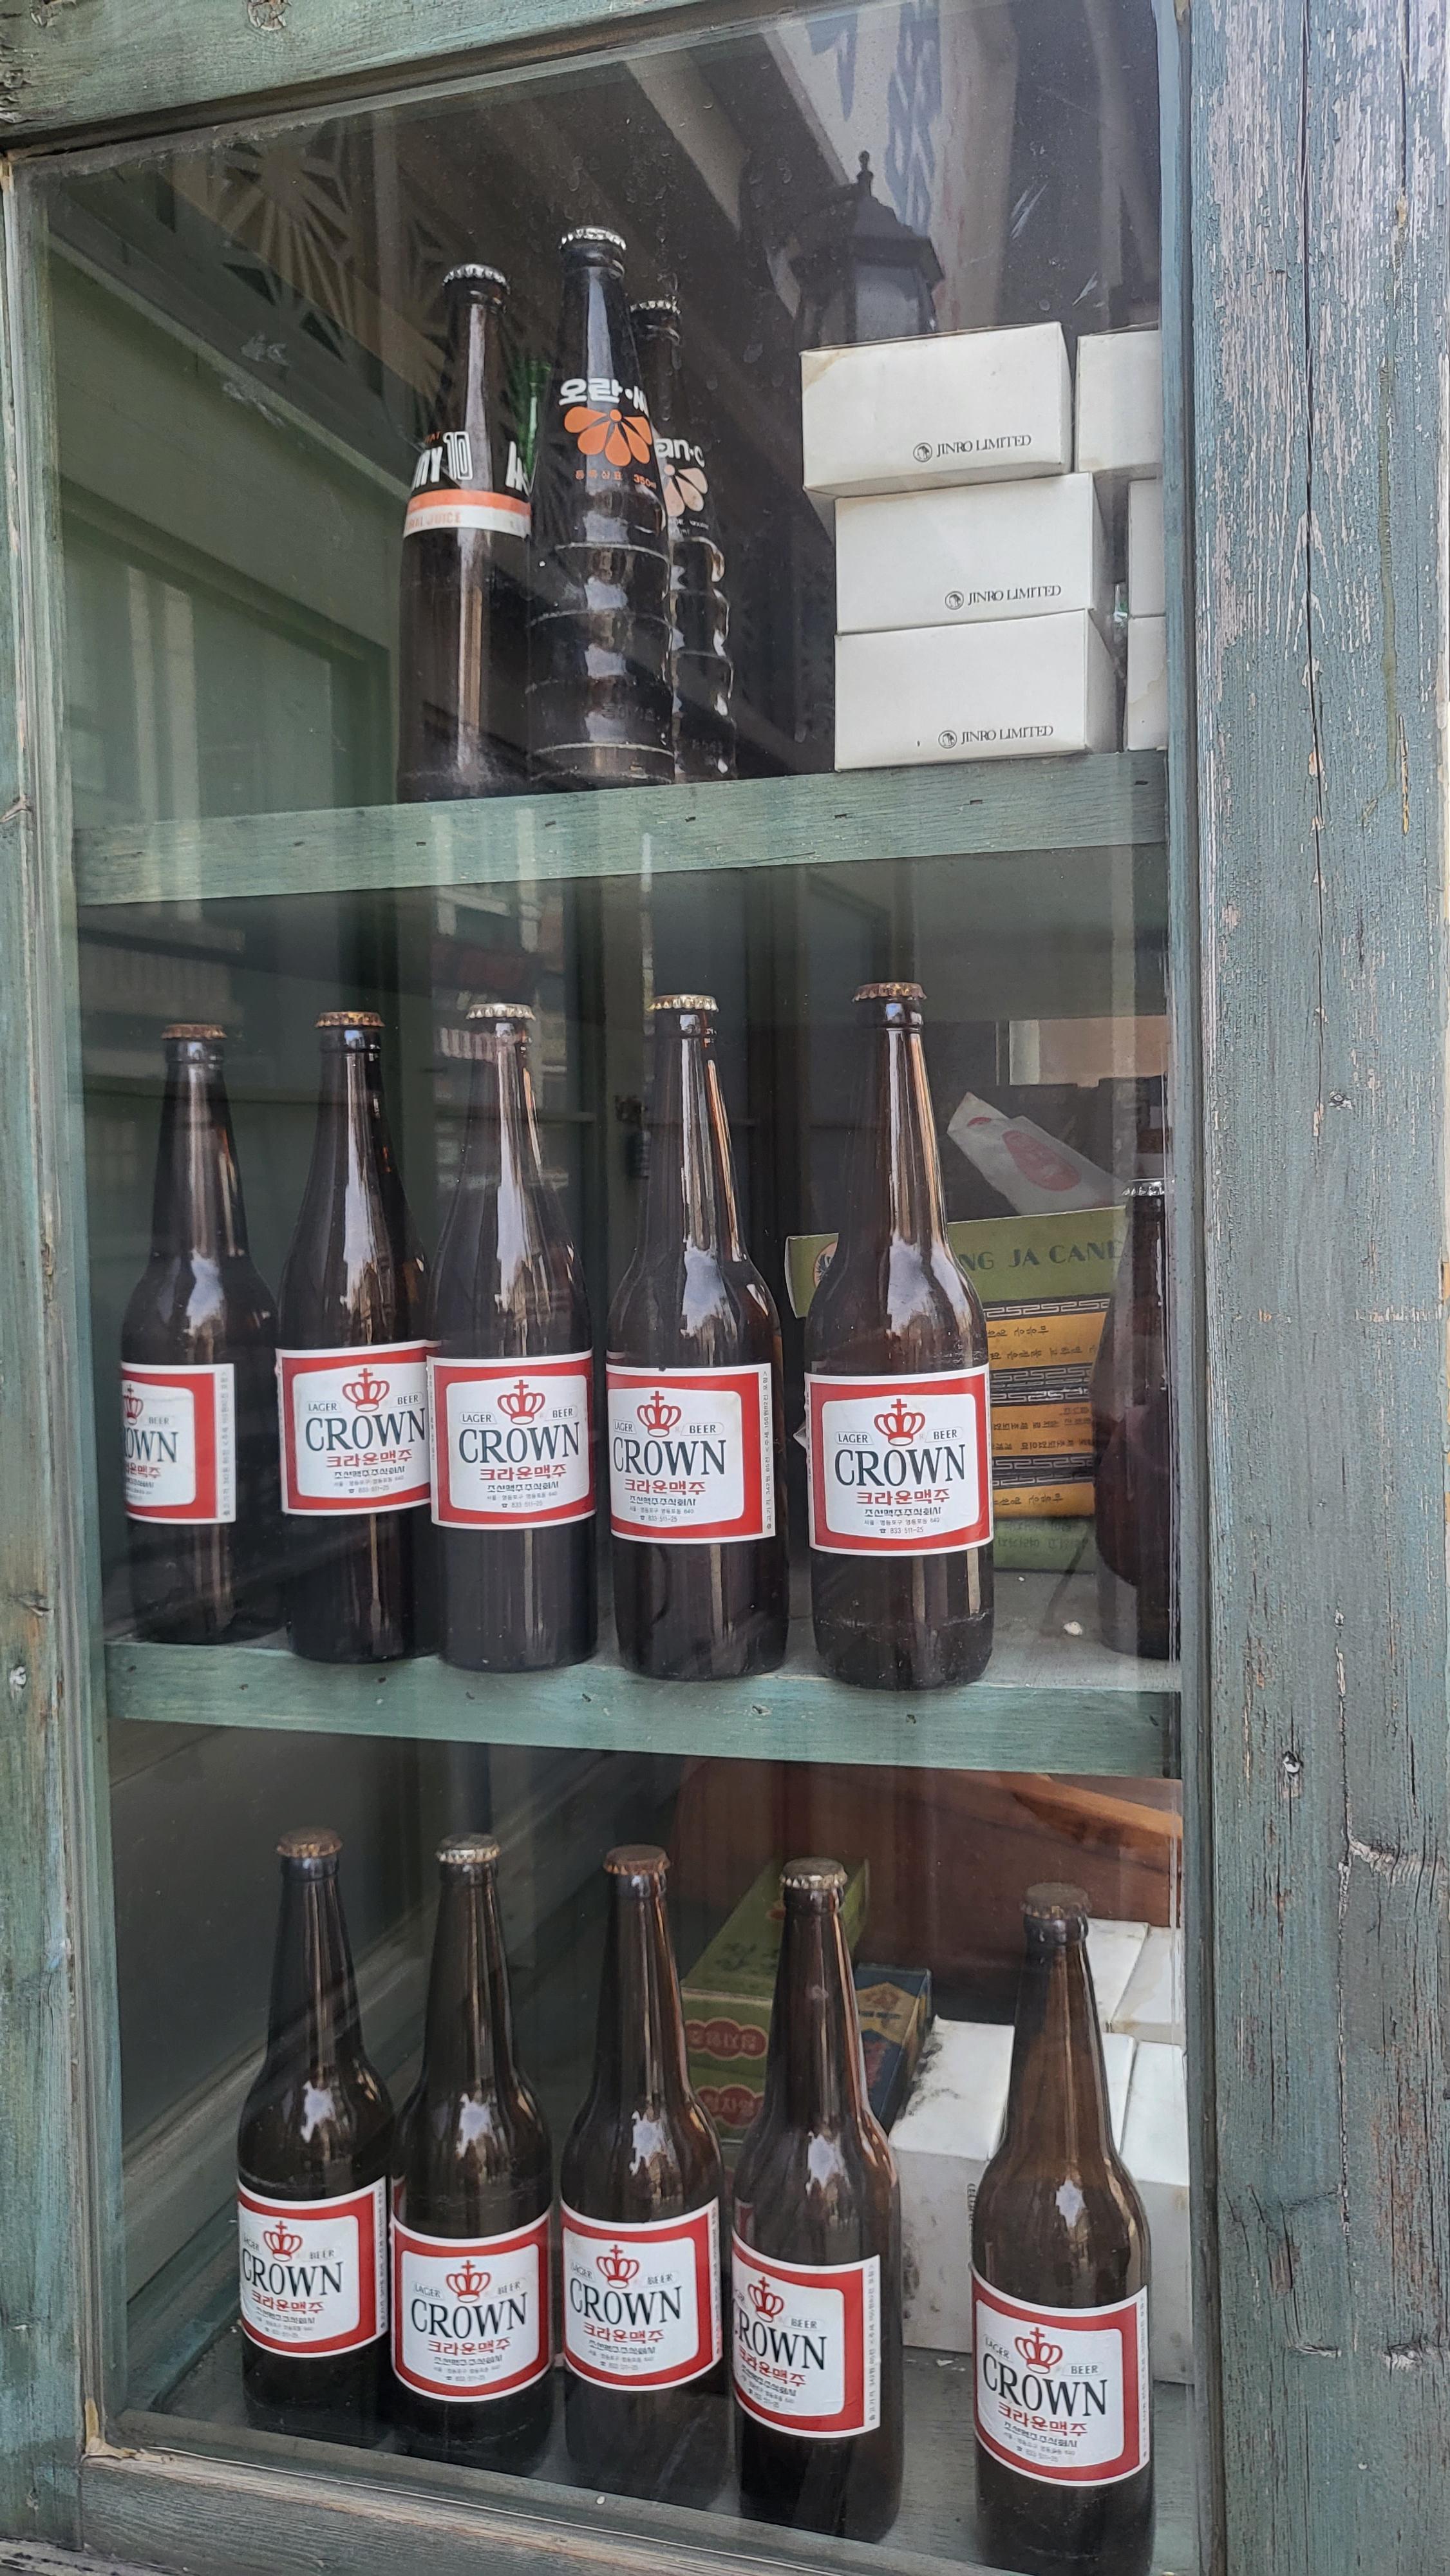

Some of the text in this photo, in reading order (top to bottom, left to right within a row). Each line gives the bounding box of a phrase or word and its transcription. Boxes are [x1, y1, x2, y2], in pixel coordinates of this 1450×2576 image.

[937, 435, 1031, 457] JINRO LIMITED
[968, 585, 1061, 605] JINRO LIMITED
[961, 725, 1053, 744] JINRO LIMITED
[959, 1240, 1123, 1271] NG JA CAND
[308, 1395, 419, 1412] LAGER BEER
[462, 1408, 573, 1423] LAGER BEER
[305, 1408, 426, 1452] CROWN
[614, 1421, 717, 1434] LAGER BEER
[838, 1429, 957, 1443] LAGER BEER
[124, 1426, 179, 1463] OWN
[458, 1422, 579, 1464] CROWN
[326, 1449, 413, 1468] 크라운맥주
[613, 1437, 726, 1476] CROWN
[834, 1444, 965, 1486] CROWN
[127, 1463, 161, 1479] 운맥주
[480, 1464, 567, 1482] 크라운맥주
[625, 1478, 706, 1495] 크라운맥주
[856, 1488, 950, 1506] 크라운맥주
[864, 1507, 941, 1517] 조선맥주주식회사
[243, 2248, 343, 2297] CROWN
[252, 2289, 324, 2314] 크라운맥주
[570, 2278, 683, 2326] CROWN
[411, 2292, 528, 2339] CROWN
[791, 2318, 818, 2329] BEER
[583, 2322, 664, 2344] 크라운맥주
[736, 2308, 827, 2371] ROWN
[428, 2336, 511, 2356] 크라운맥주
[1071, 2365, 1098, 2374] BEER
[983, 2353, 1107, 2416] CROWN
[999, 2401, 1088, 2436] 크라운맥주
